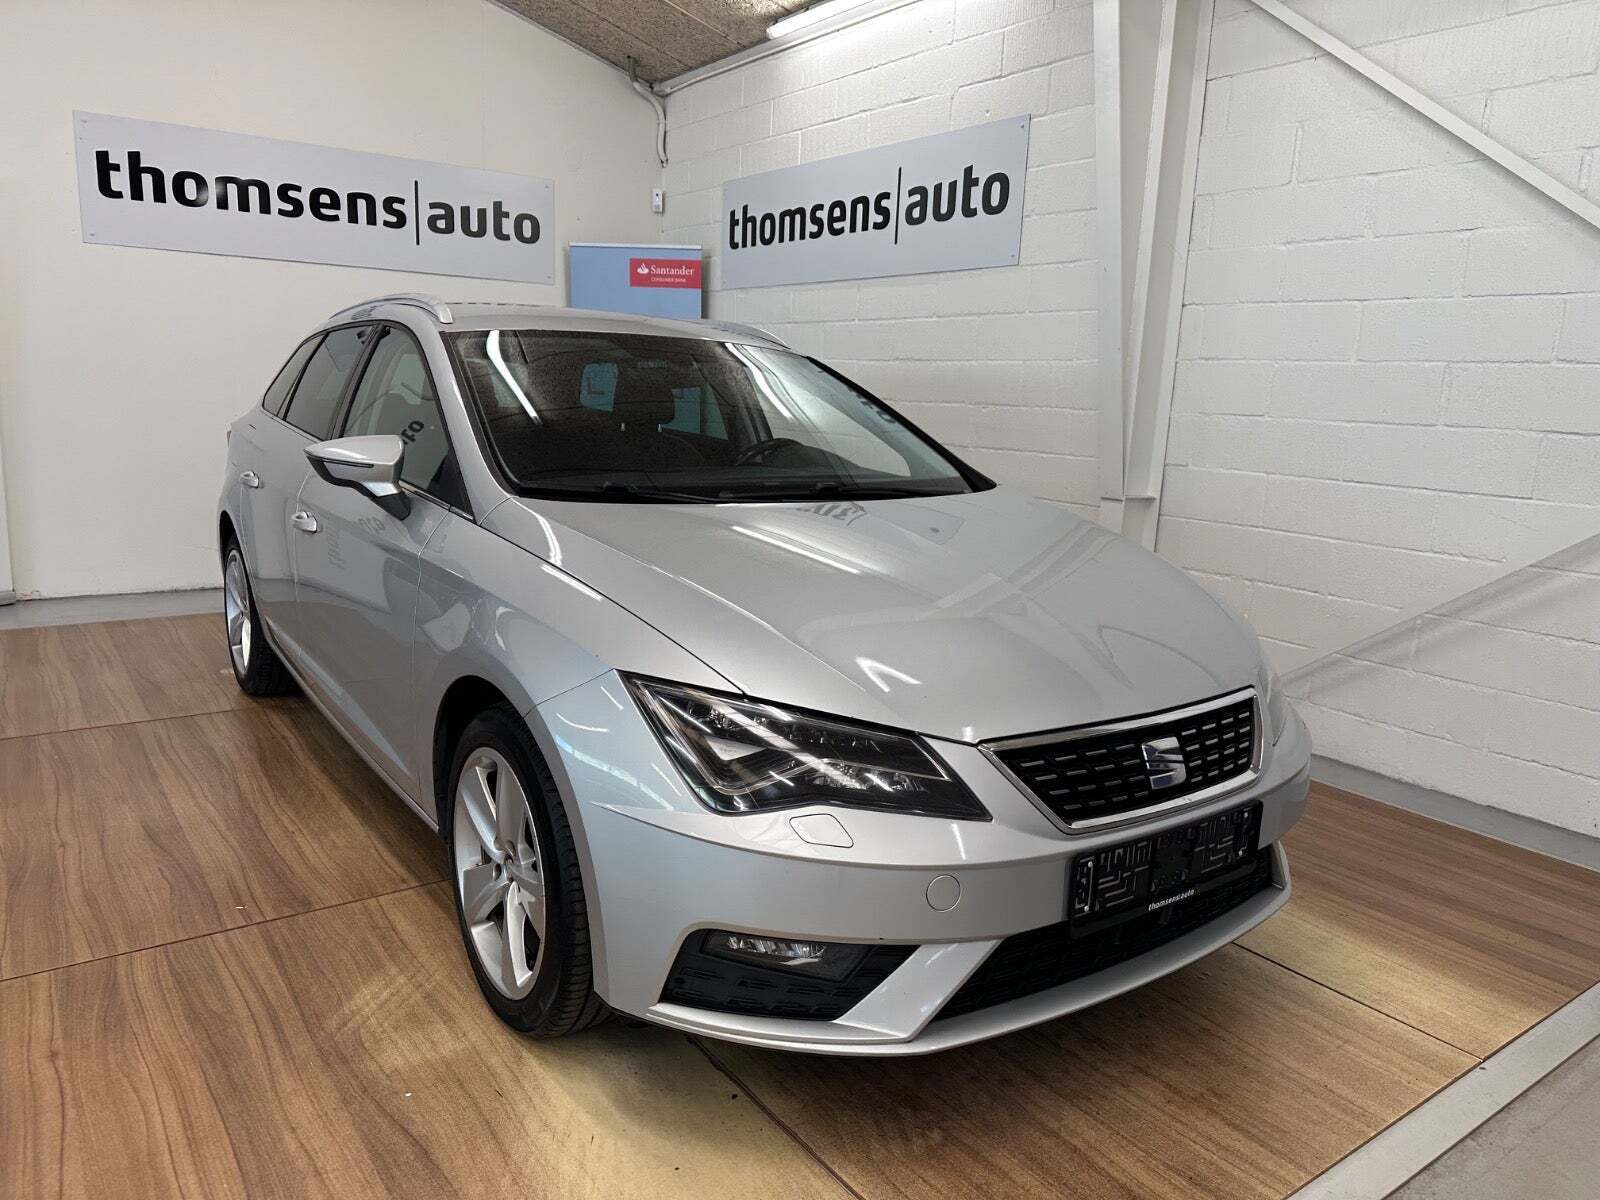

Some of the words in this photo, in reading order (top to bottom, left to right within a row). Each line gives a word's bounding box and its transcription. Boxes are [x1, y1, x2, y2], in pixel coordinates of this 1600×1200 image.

[95, 150, 407, 230] thomsens
[427, 200, 541, 245] auto
[729, 191, 891, 250] thomsens
[905, 164, 1010, 226] auto
[650, 264, 694, 276] Santander
